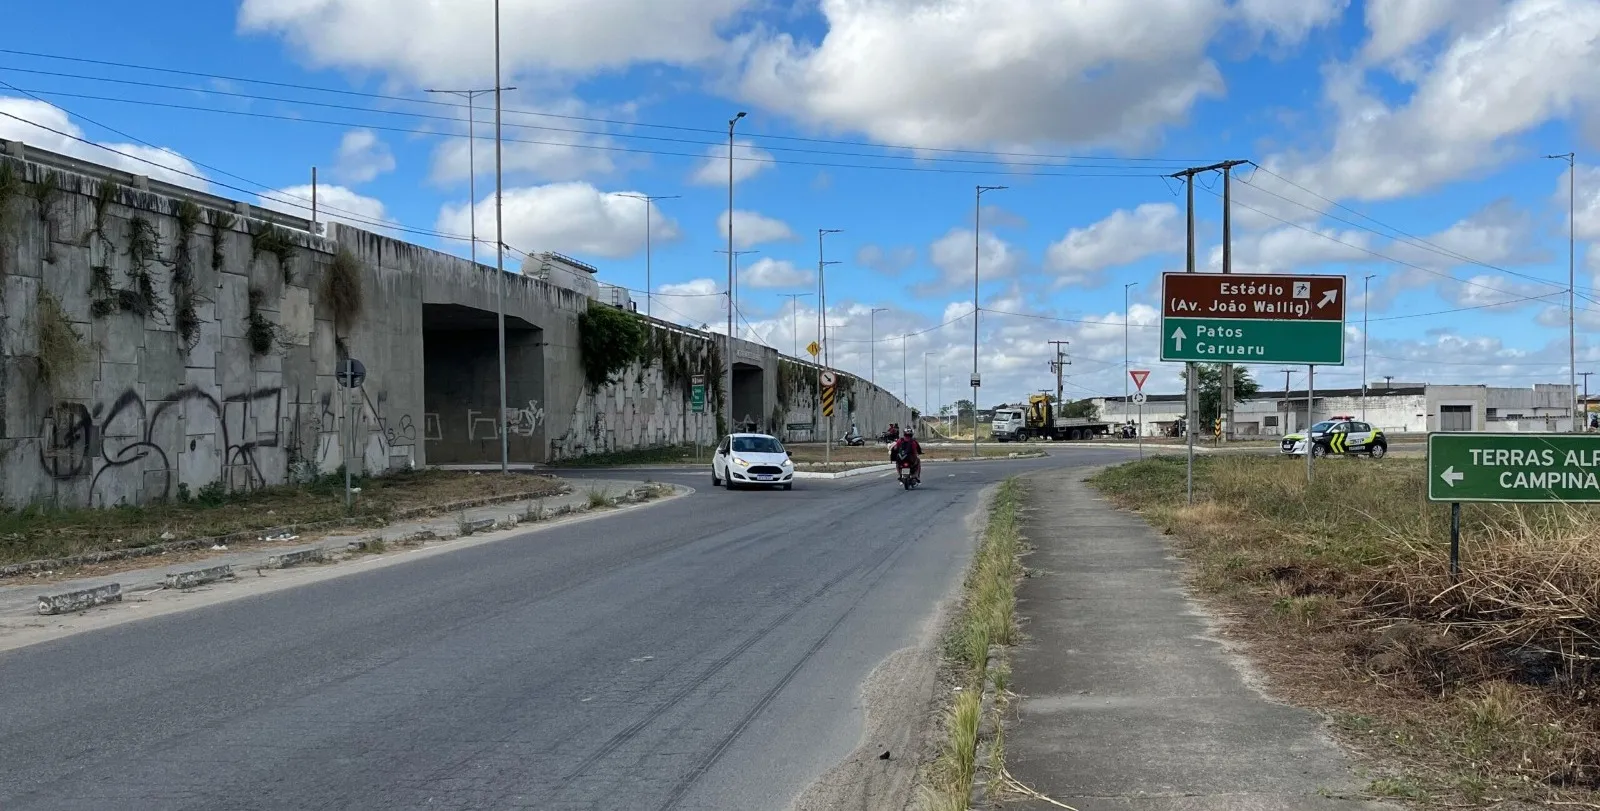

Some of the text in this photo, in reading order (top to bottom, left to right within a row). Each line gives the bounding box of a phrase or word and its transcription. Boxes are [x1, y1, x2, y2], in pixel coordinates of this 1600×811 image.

[1220, 281, 1283, 296] Estádio
[1171, 298, 1310, 317] (Av. João Wallig)
[1196, 325, 1243, 338] Patos
[1196, 342, 1264, 355] Caruaru
[1468, 449, 1555, 466] TERRAS
[1499, 472, 1600, 489] CAMPINA
